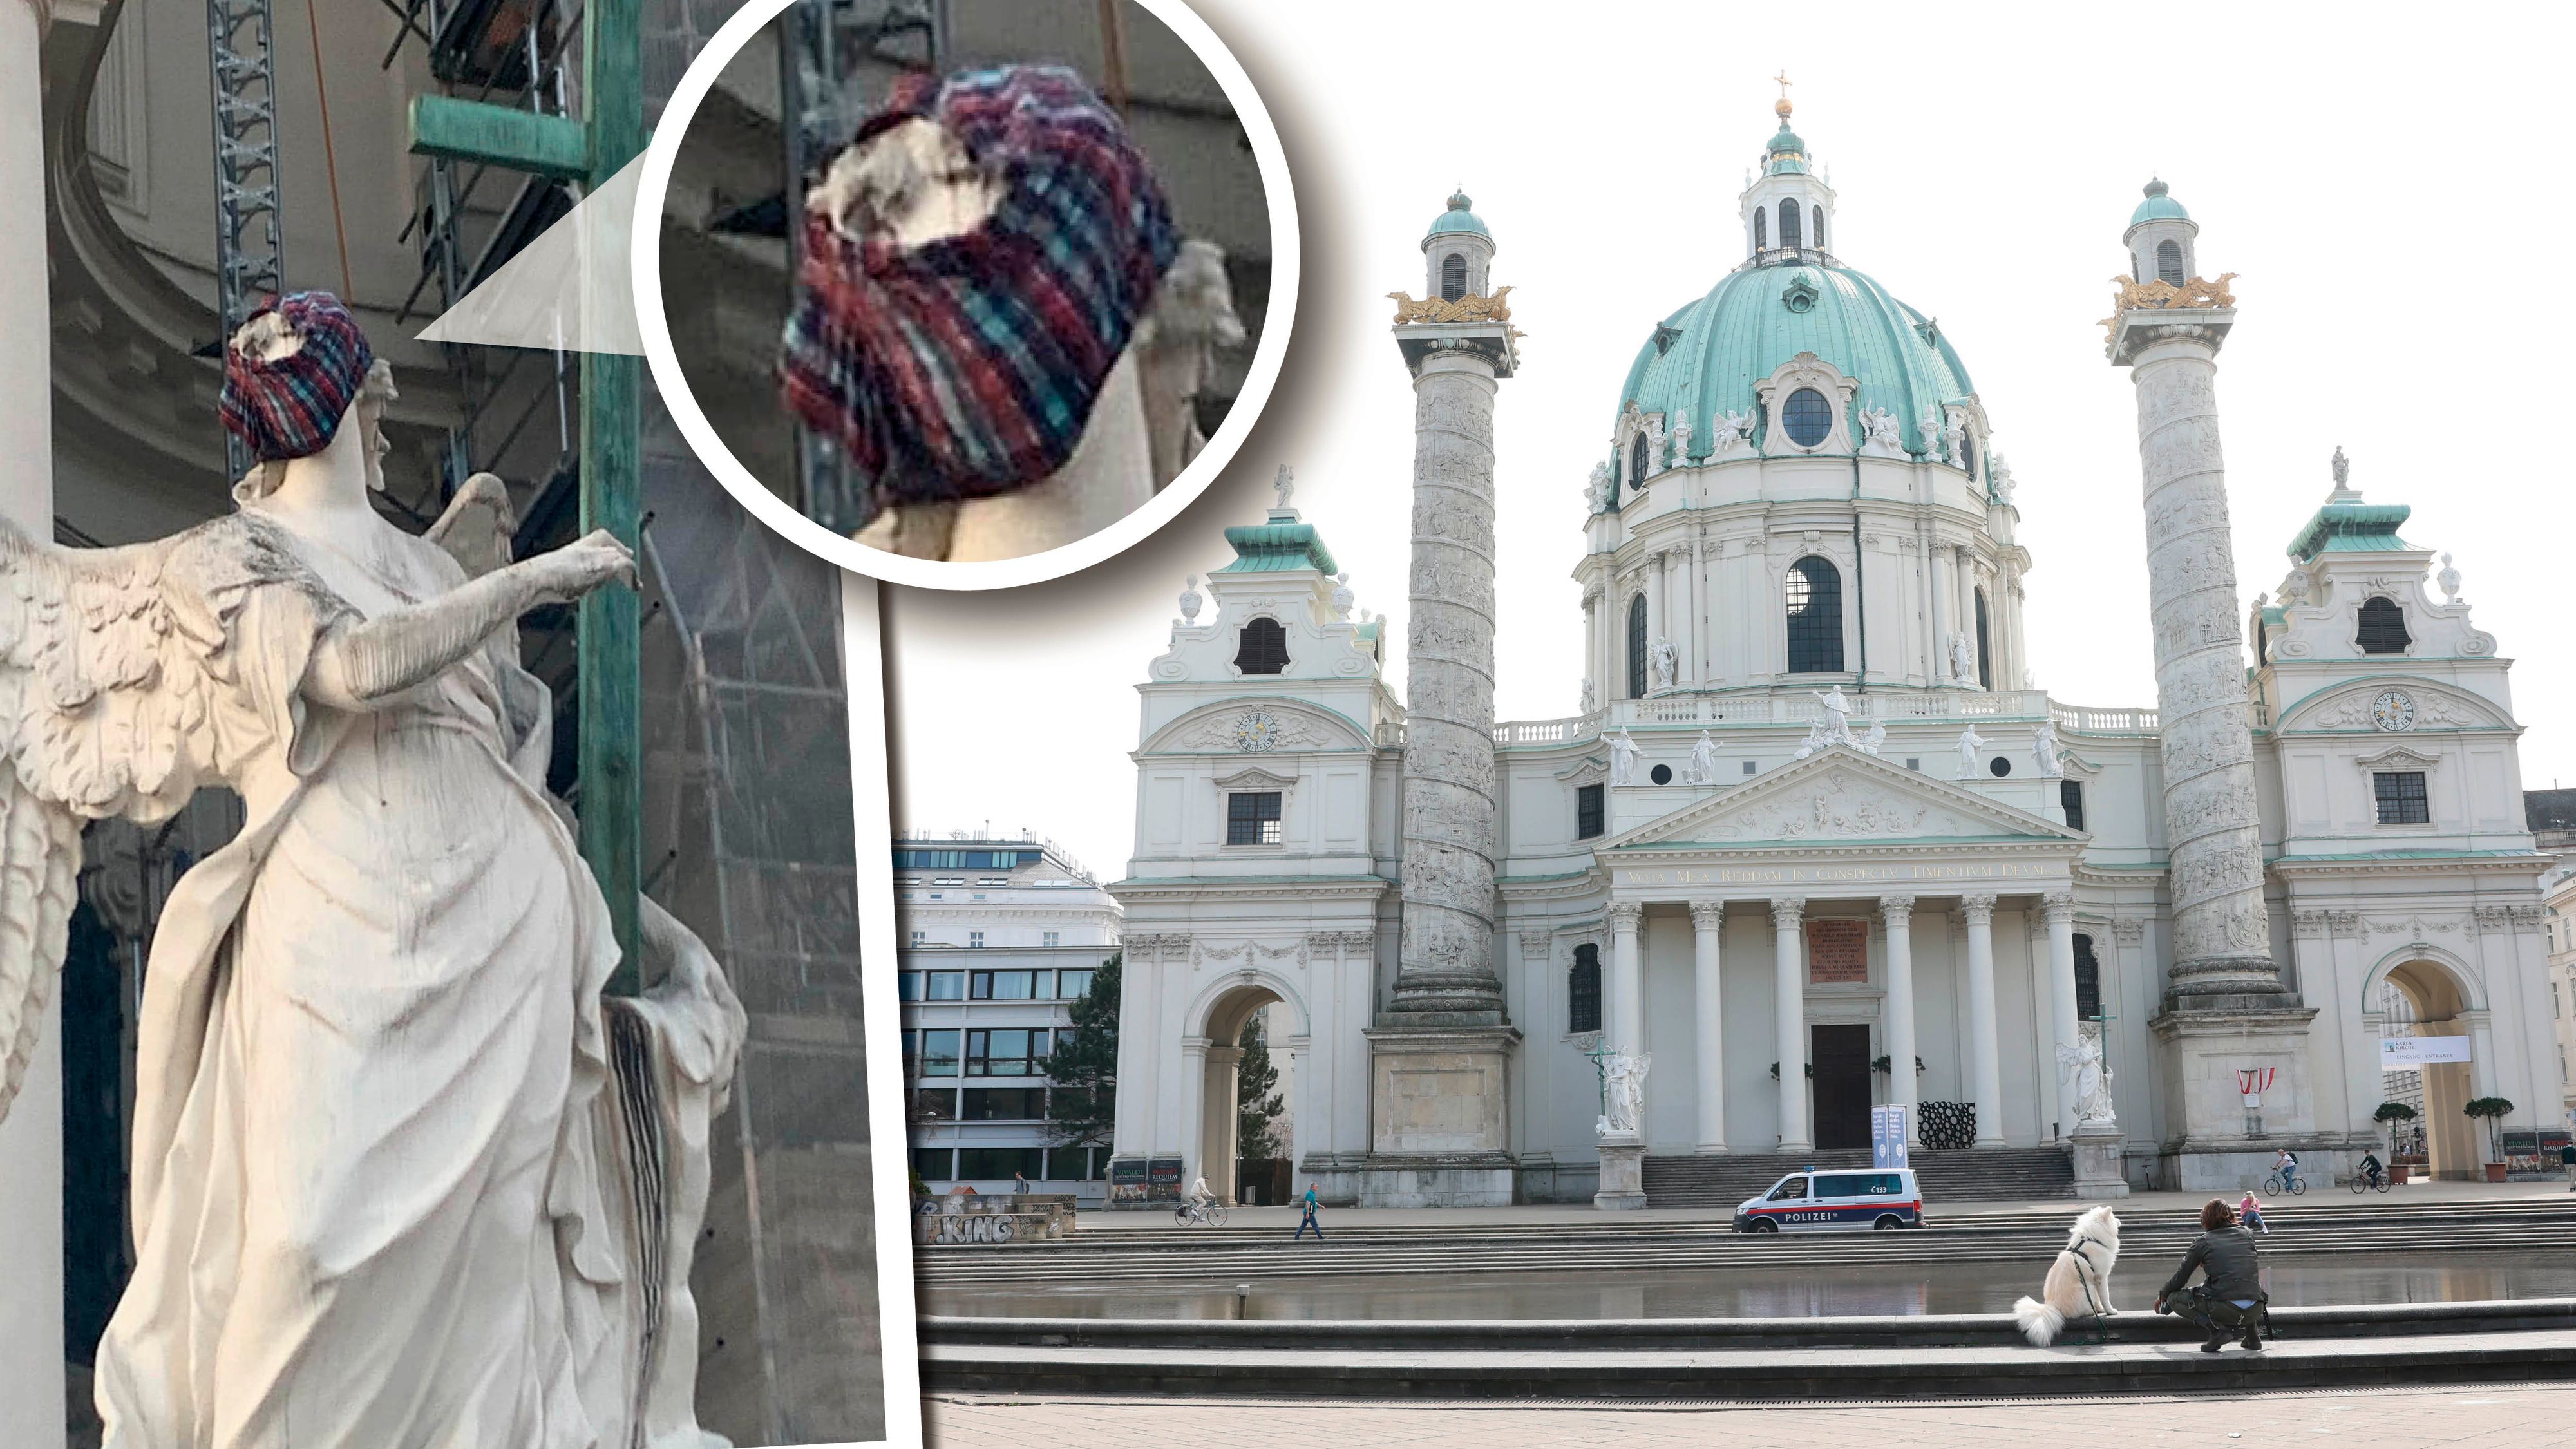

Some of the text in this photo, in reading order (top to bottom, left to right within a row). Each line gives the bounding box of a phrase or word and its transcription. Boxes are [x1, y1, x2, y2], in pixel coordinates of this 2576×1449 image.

[1722, 869, 1781, 882] REDDAM
[1792, 868, 1805, 880] IN
[1817, 866, 1899, 880] CONSPECTV
[1910, 864, 1992, 878] TIMENTIVM
[1785, 1212, 1831, 1222] POLIZEI
